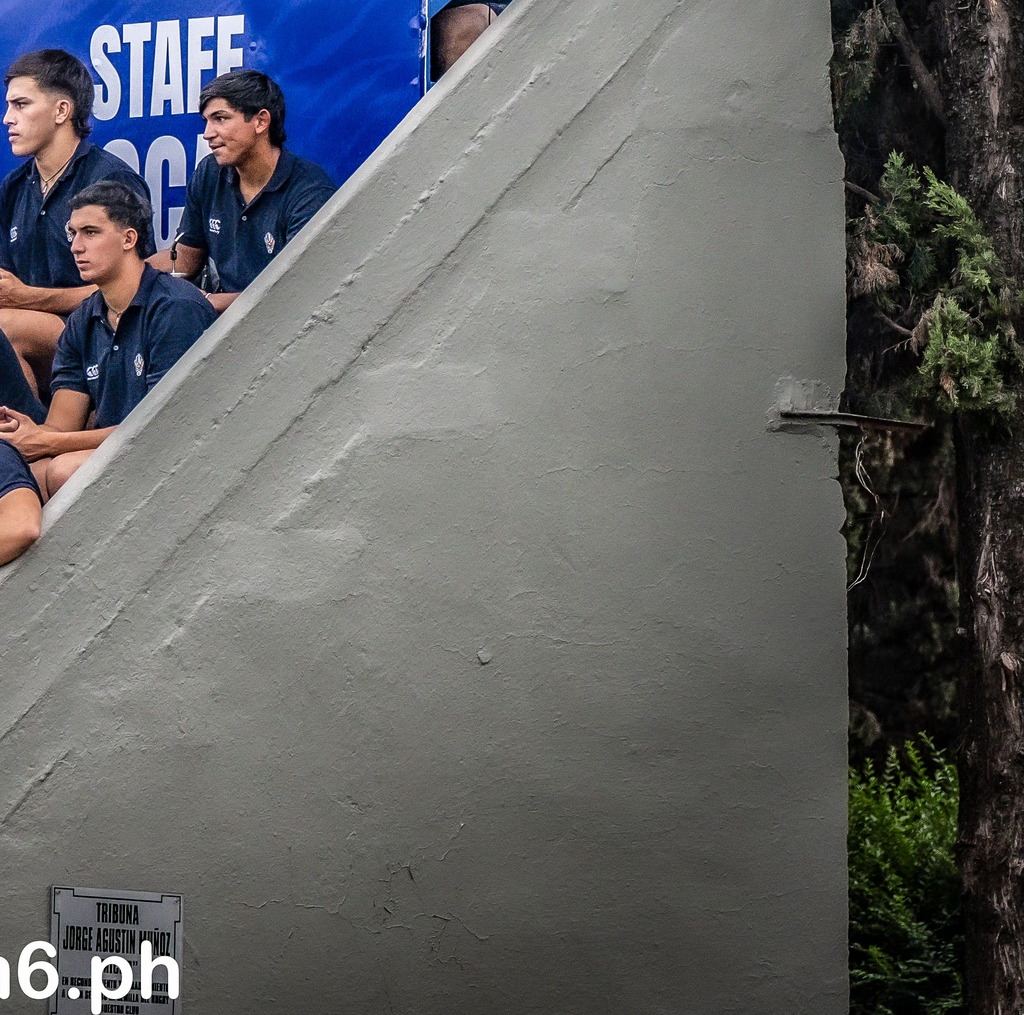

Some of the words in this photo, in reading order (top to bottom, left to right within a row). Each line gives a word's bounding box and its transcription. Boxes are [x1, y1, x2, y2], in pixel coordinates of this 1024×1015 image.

[89, 14, 245, 122] STAFF
[96, 902, 139, 925] TRIBUNA
[63, 925, 93, 951] JORGE
[96, 927, 136, 954] AGUSTIN
